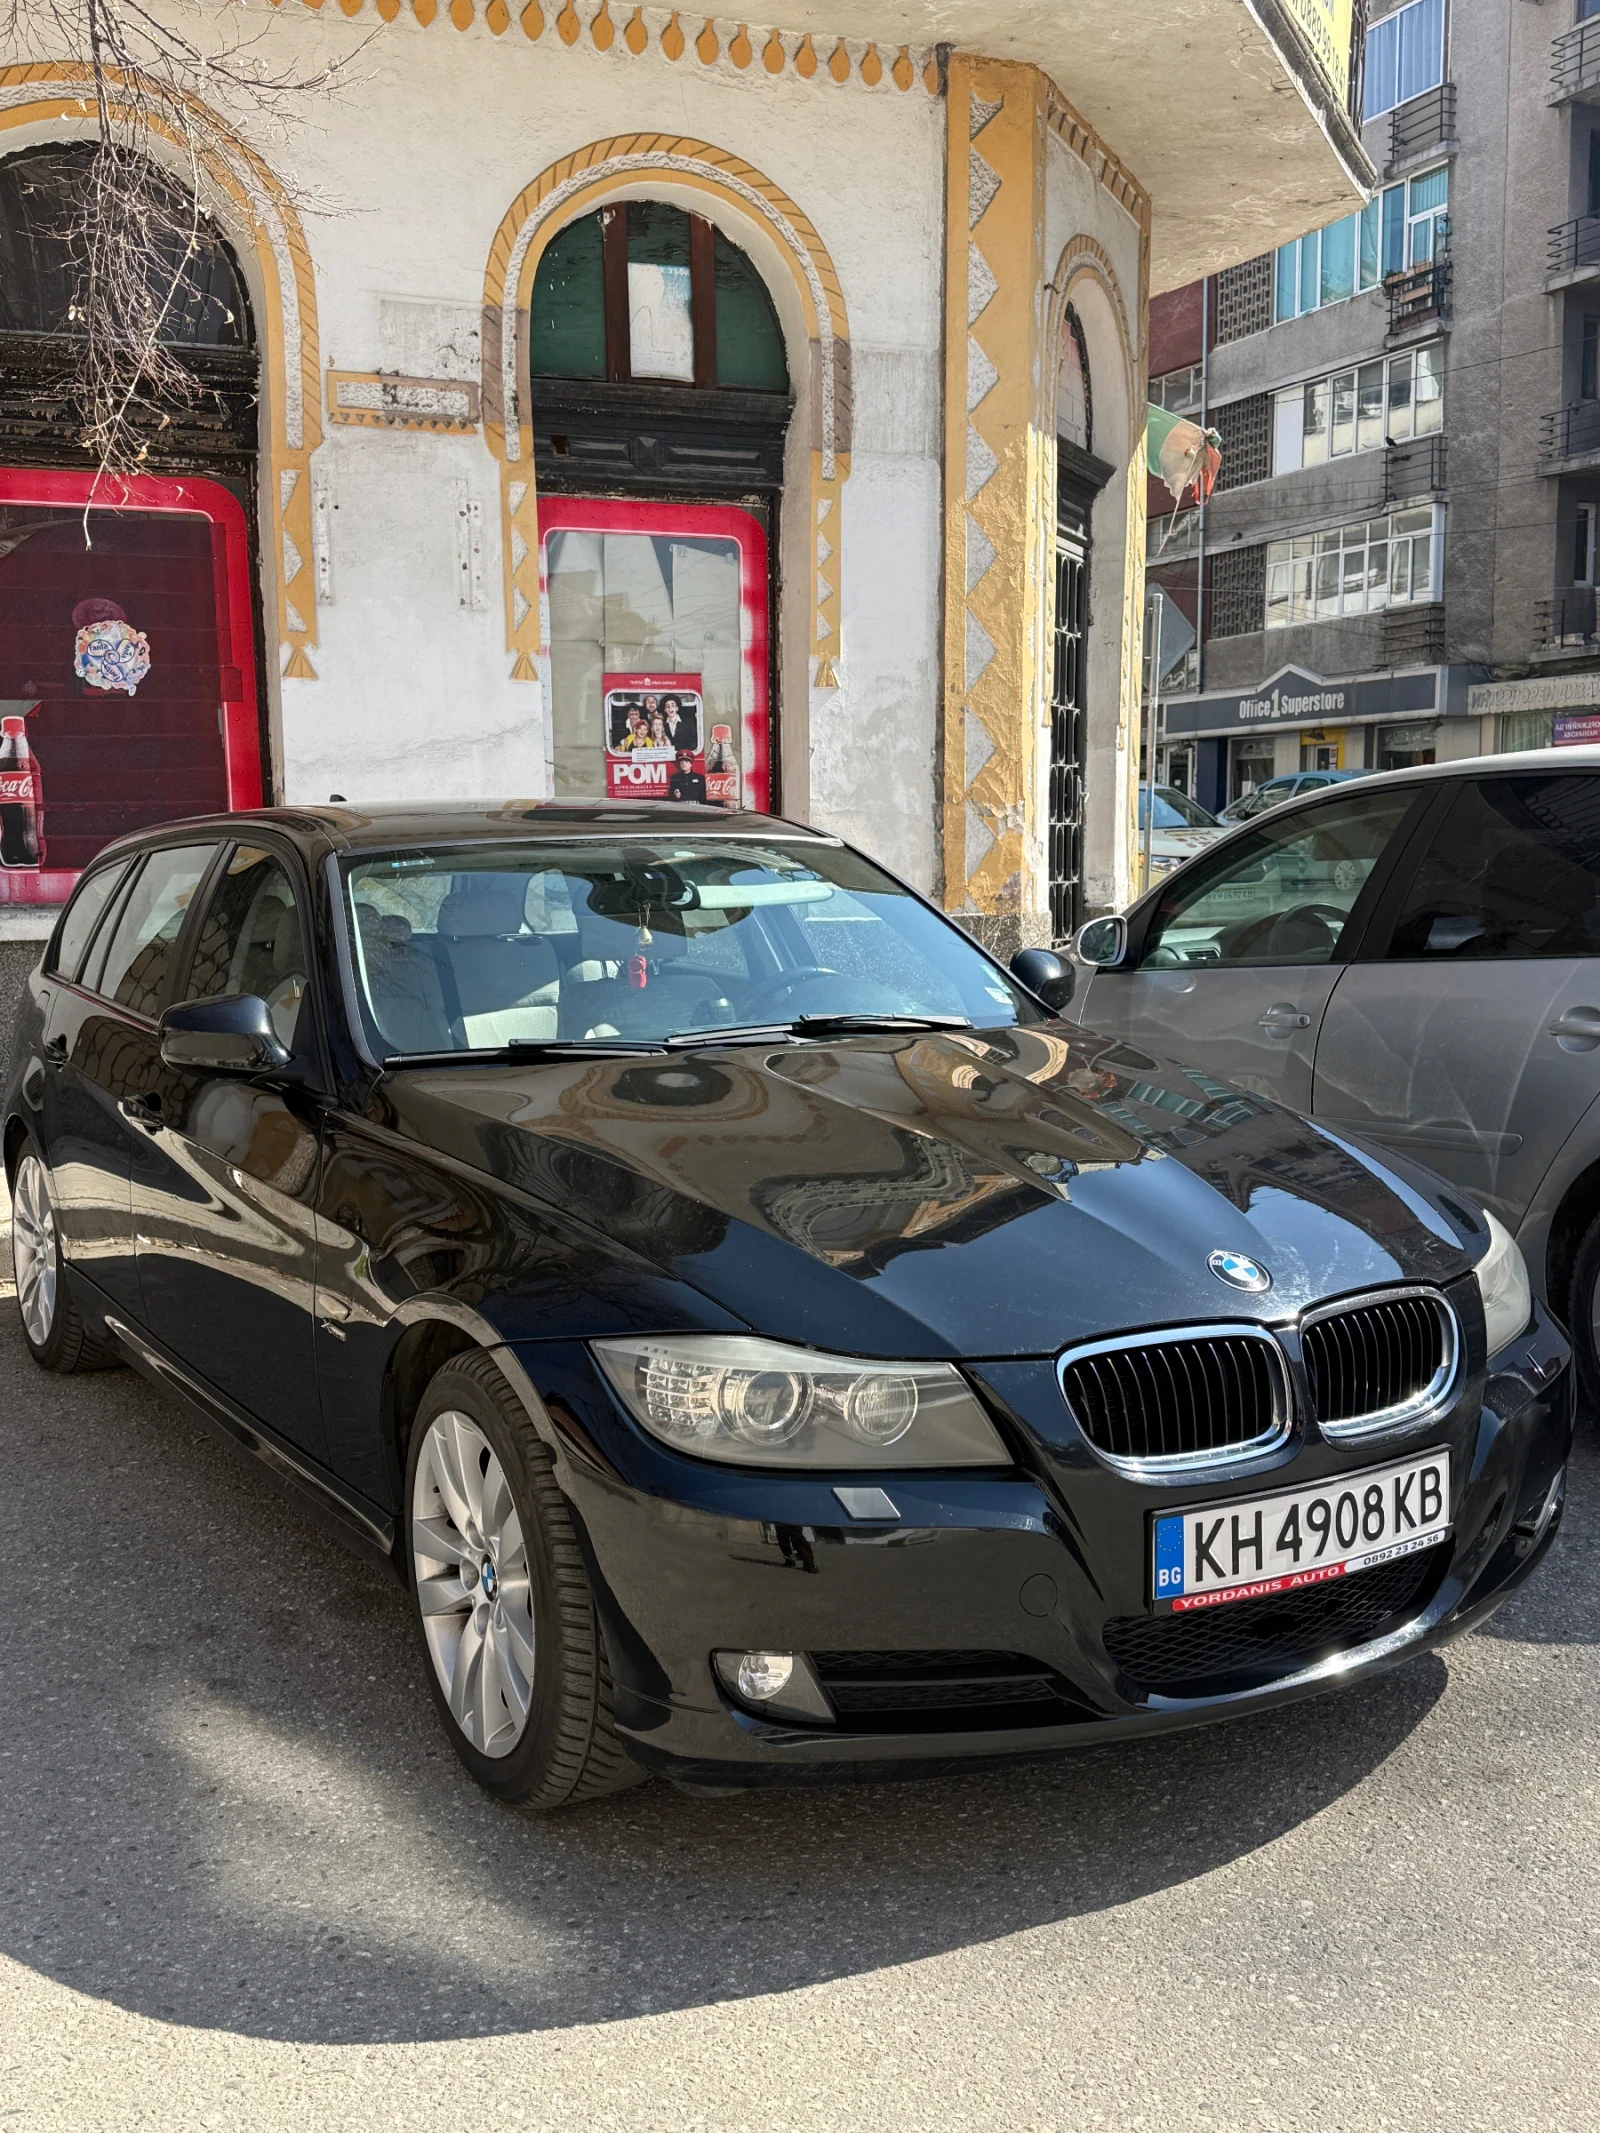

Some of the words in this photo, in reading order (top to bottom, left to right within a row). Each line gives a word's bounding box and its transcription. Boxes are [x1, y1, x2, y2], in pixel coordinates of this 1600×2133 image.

[90, 643, 109, 651] Fanta
[1239, 699, 1271, 719] Office
[1271, 689, 1281, 718] 1
[1281, 692, 1345, 716] Superstore
[1363, 1550, 1393, 1565] 0892
[1395, 1544, 1409, 1555] 23
[1411, 1540, 1424, 1550] 24
[1426, 1534, 1439, 1544] 56
[1158, 1566, 1182, 1587] BG
[1180, 1580, 1283, 1608] YORDANIS
[1290, 1567, 1340, 1588] AUTO
